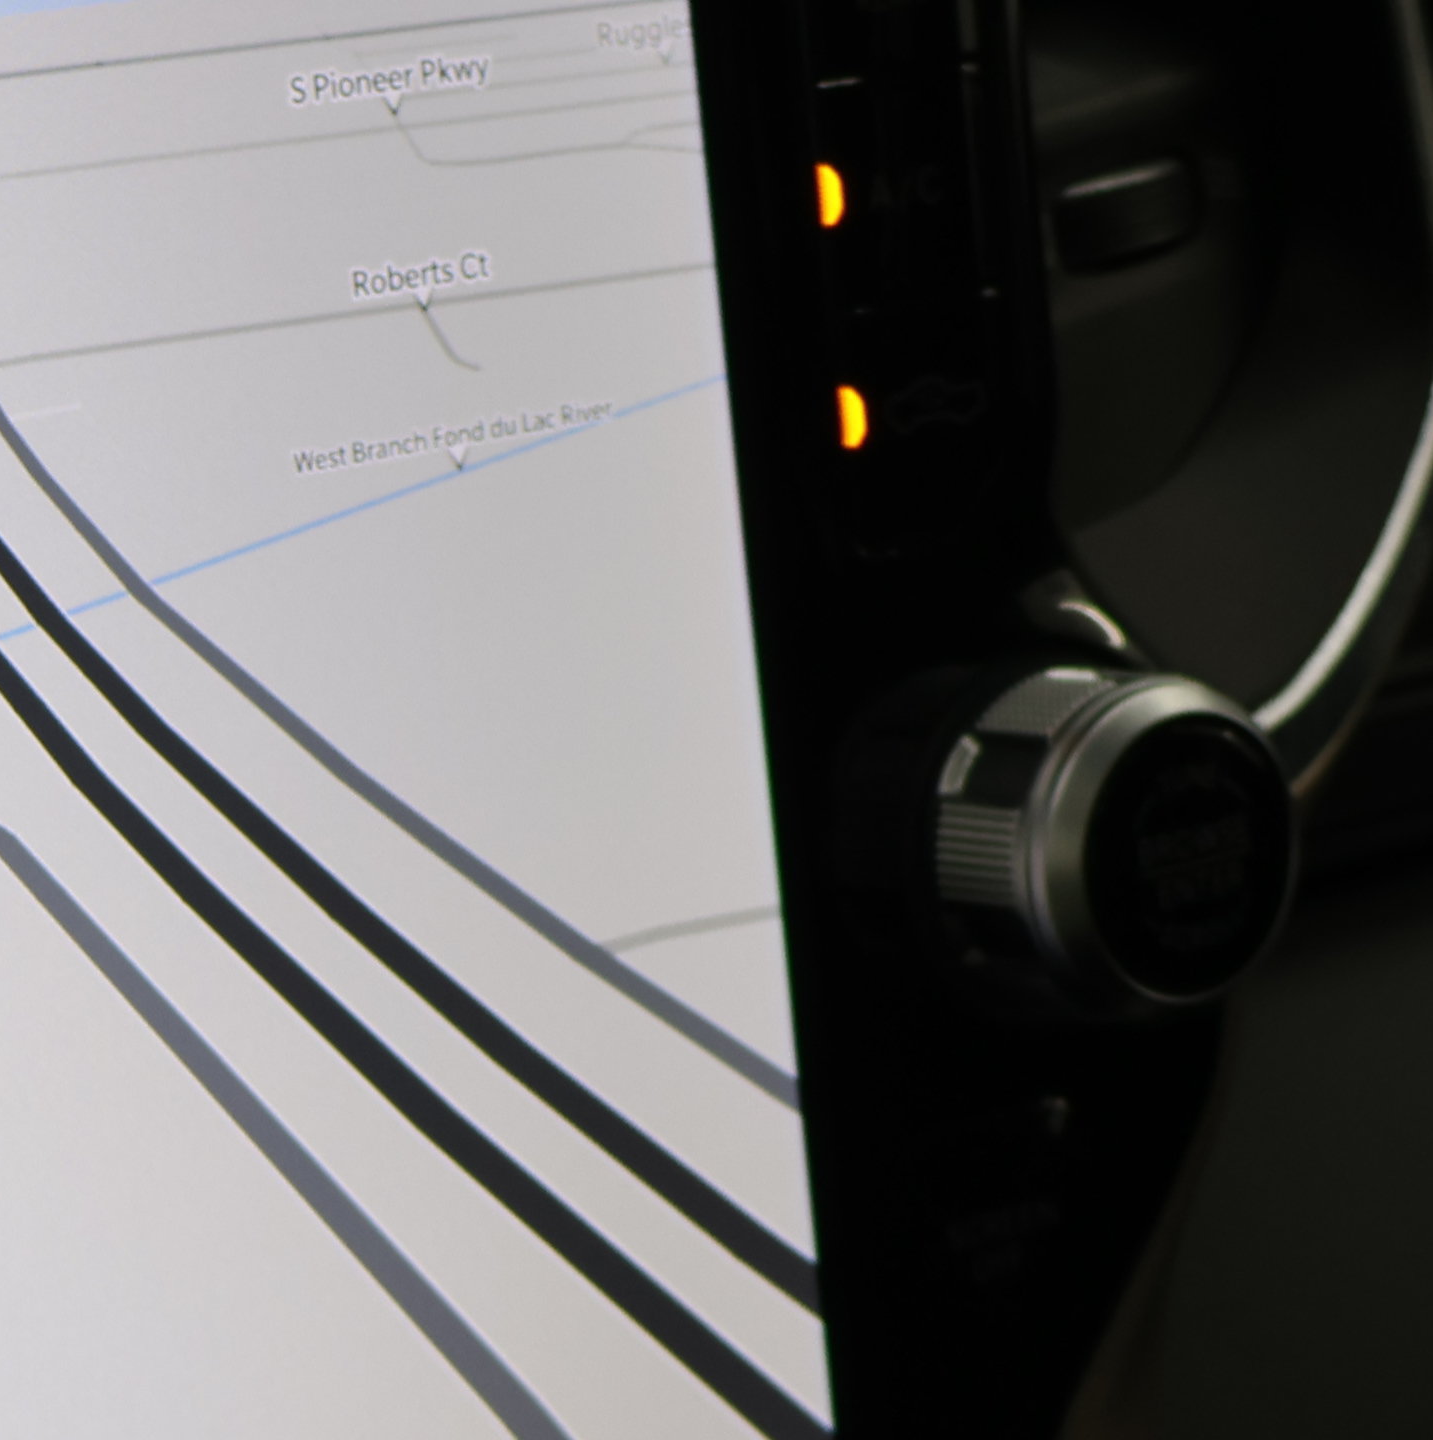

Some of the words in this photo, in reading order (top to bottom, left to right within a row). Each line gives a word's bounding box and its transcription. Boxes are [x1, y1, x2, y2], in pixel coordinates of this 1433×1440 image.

[596, 13, 688, 50] Ruggle
[290, 77, 306, 103] S
[313, 65, 414, 102] Pioneer
[421, 56, 490, 87] Pkwy
[353, 256, 455, 297] Roberts
[460, 253, 490, 281] Ct
[293, 446, 348, 474] West
[353, 432, 428, 464] Branch
[433, 421, 485, 450] Fond
[491, 415, 518, 439] du
[522, 410, 556, 433] Lac
[560, 401, 615, 426] River
